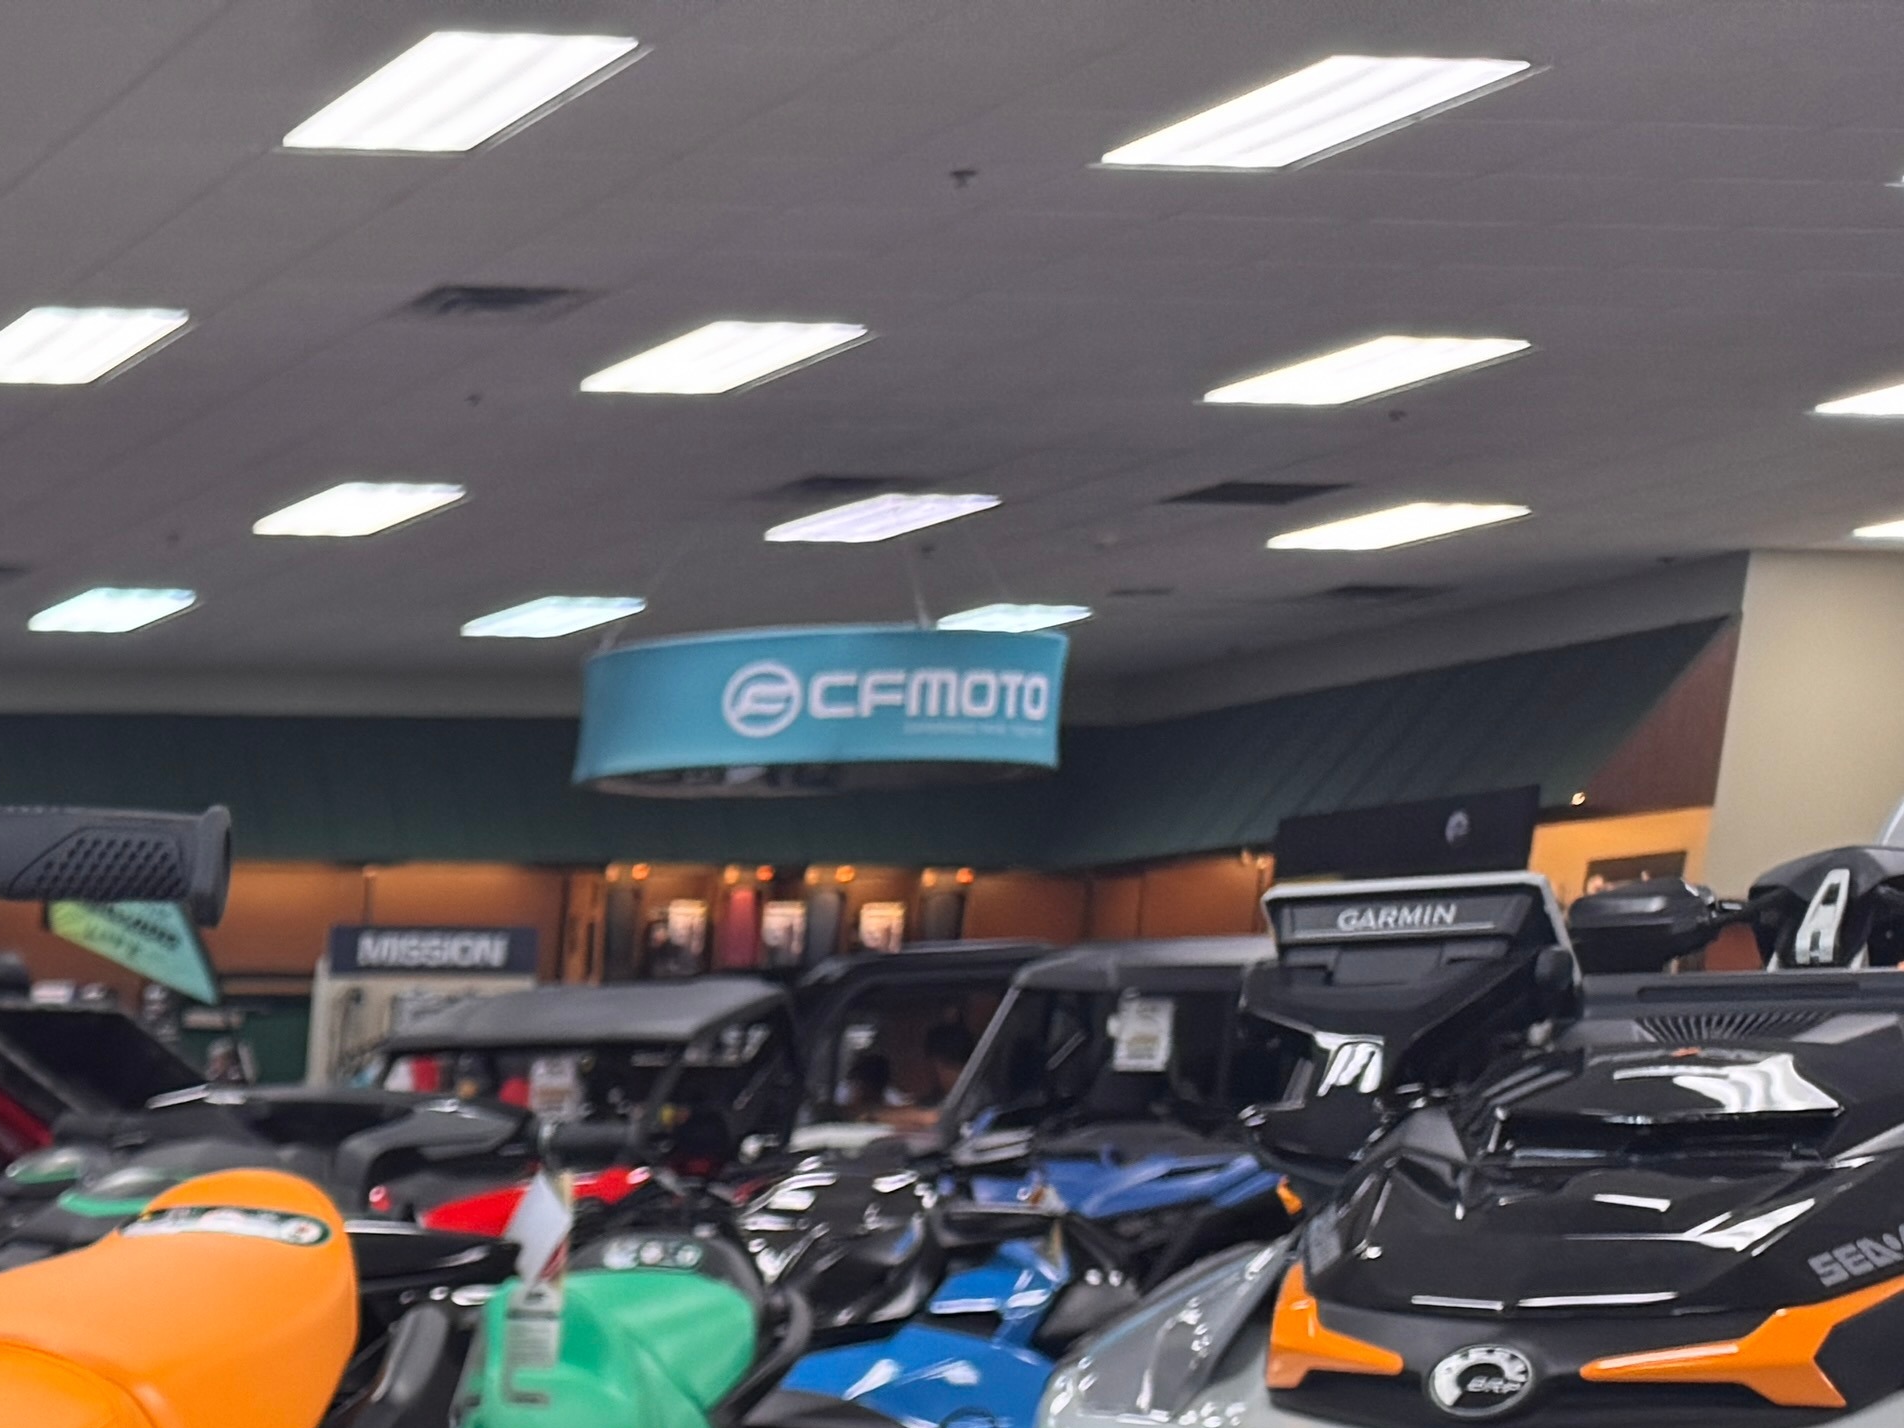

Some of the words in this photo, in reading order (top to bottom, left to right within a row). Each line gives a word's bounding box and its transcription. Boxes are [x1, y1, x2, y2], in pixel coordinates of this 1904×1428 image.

[808, 667, 1048, 720] CFMOTO
[1337, 903, 1457, 931] GARMIN
[358, 930, 511, 967] MISSION
